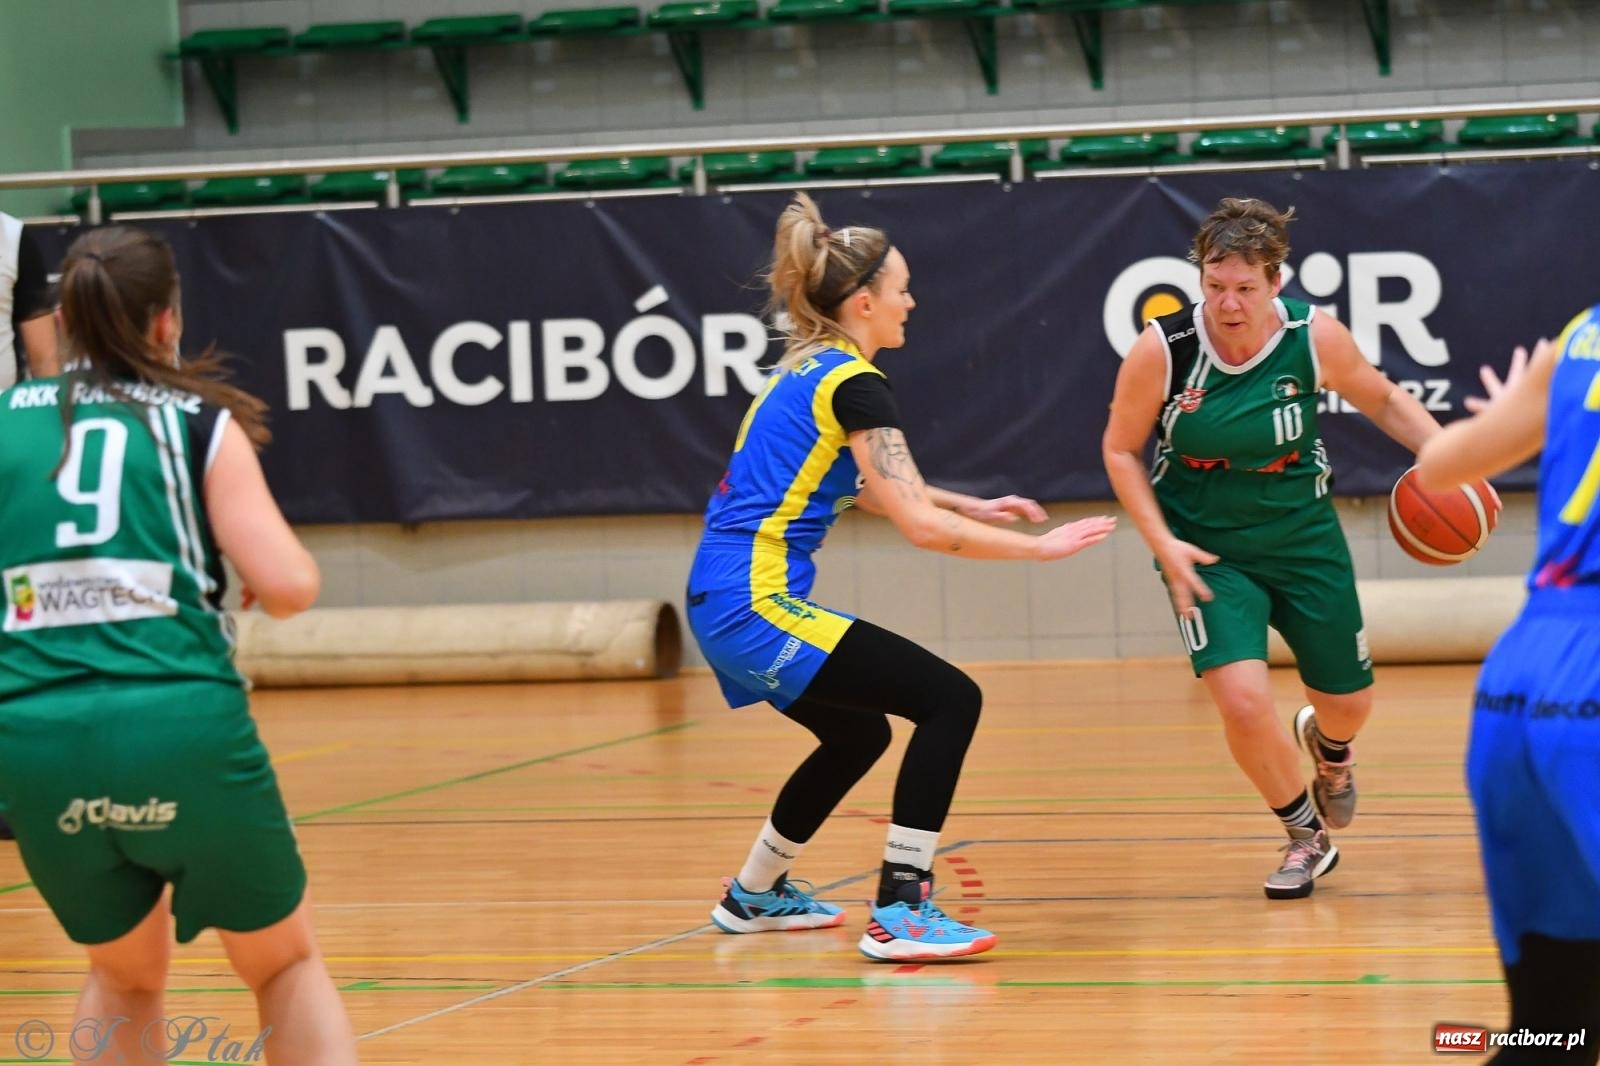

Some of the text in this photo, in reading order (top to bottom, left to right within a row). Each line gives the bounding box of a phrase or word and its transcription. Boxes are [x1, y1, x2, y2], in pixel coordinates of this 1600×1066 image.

[283, 284, 799, 410] RACIBÓR
[1103, 252, 1450, 373] OiR
[9, 383, 60, 409] RKK
[1272, 404, 1304, 446] 10
[55, 417, 128, 548] 9
[38, 585, 163, 613] WAGTEC
